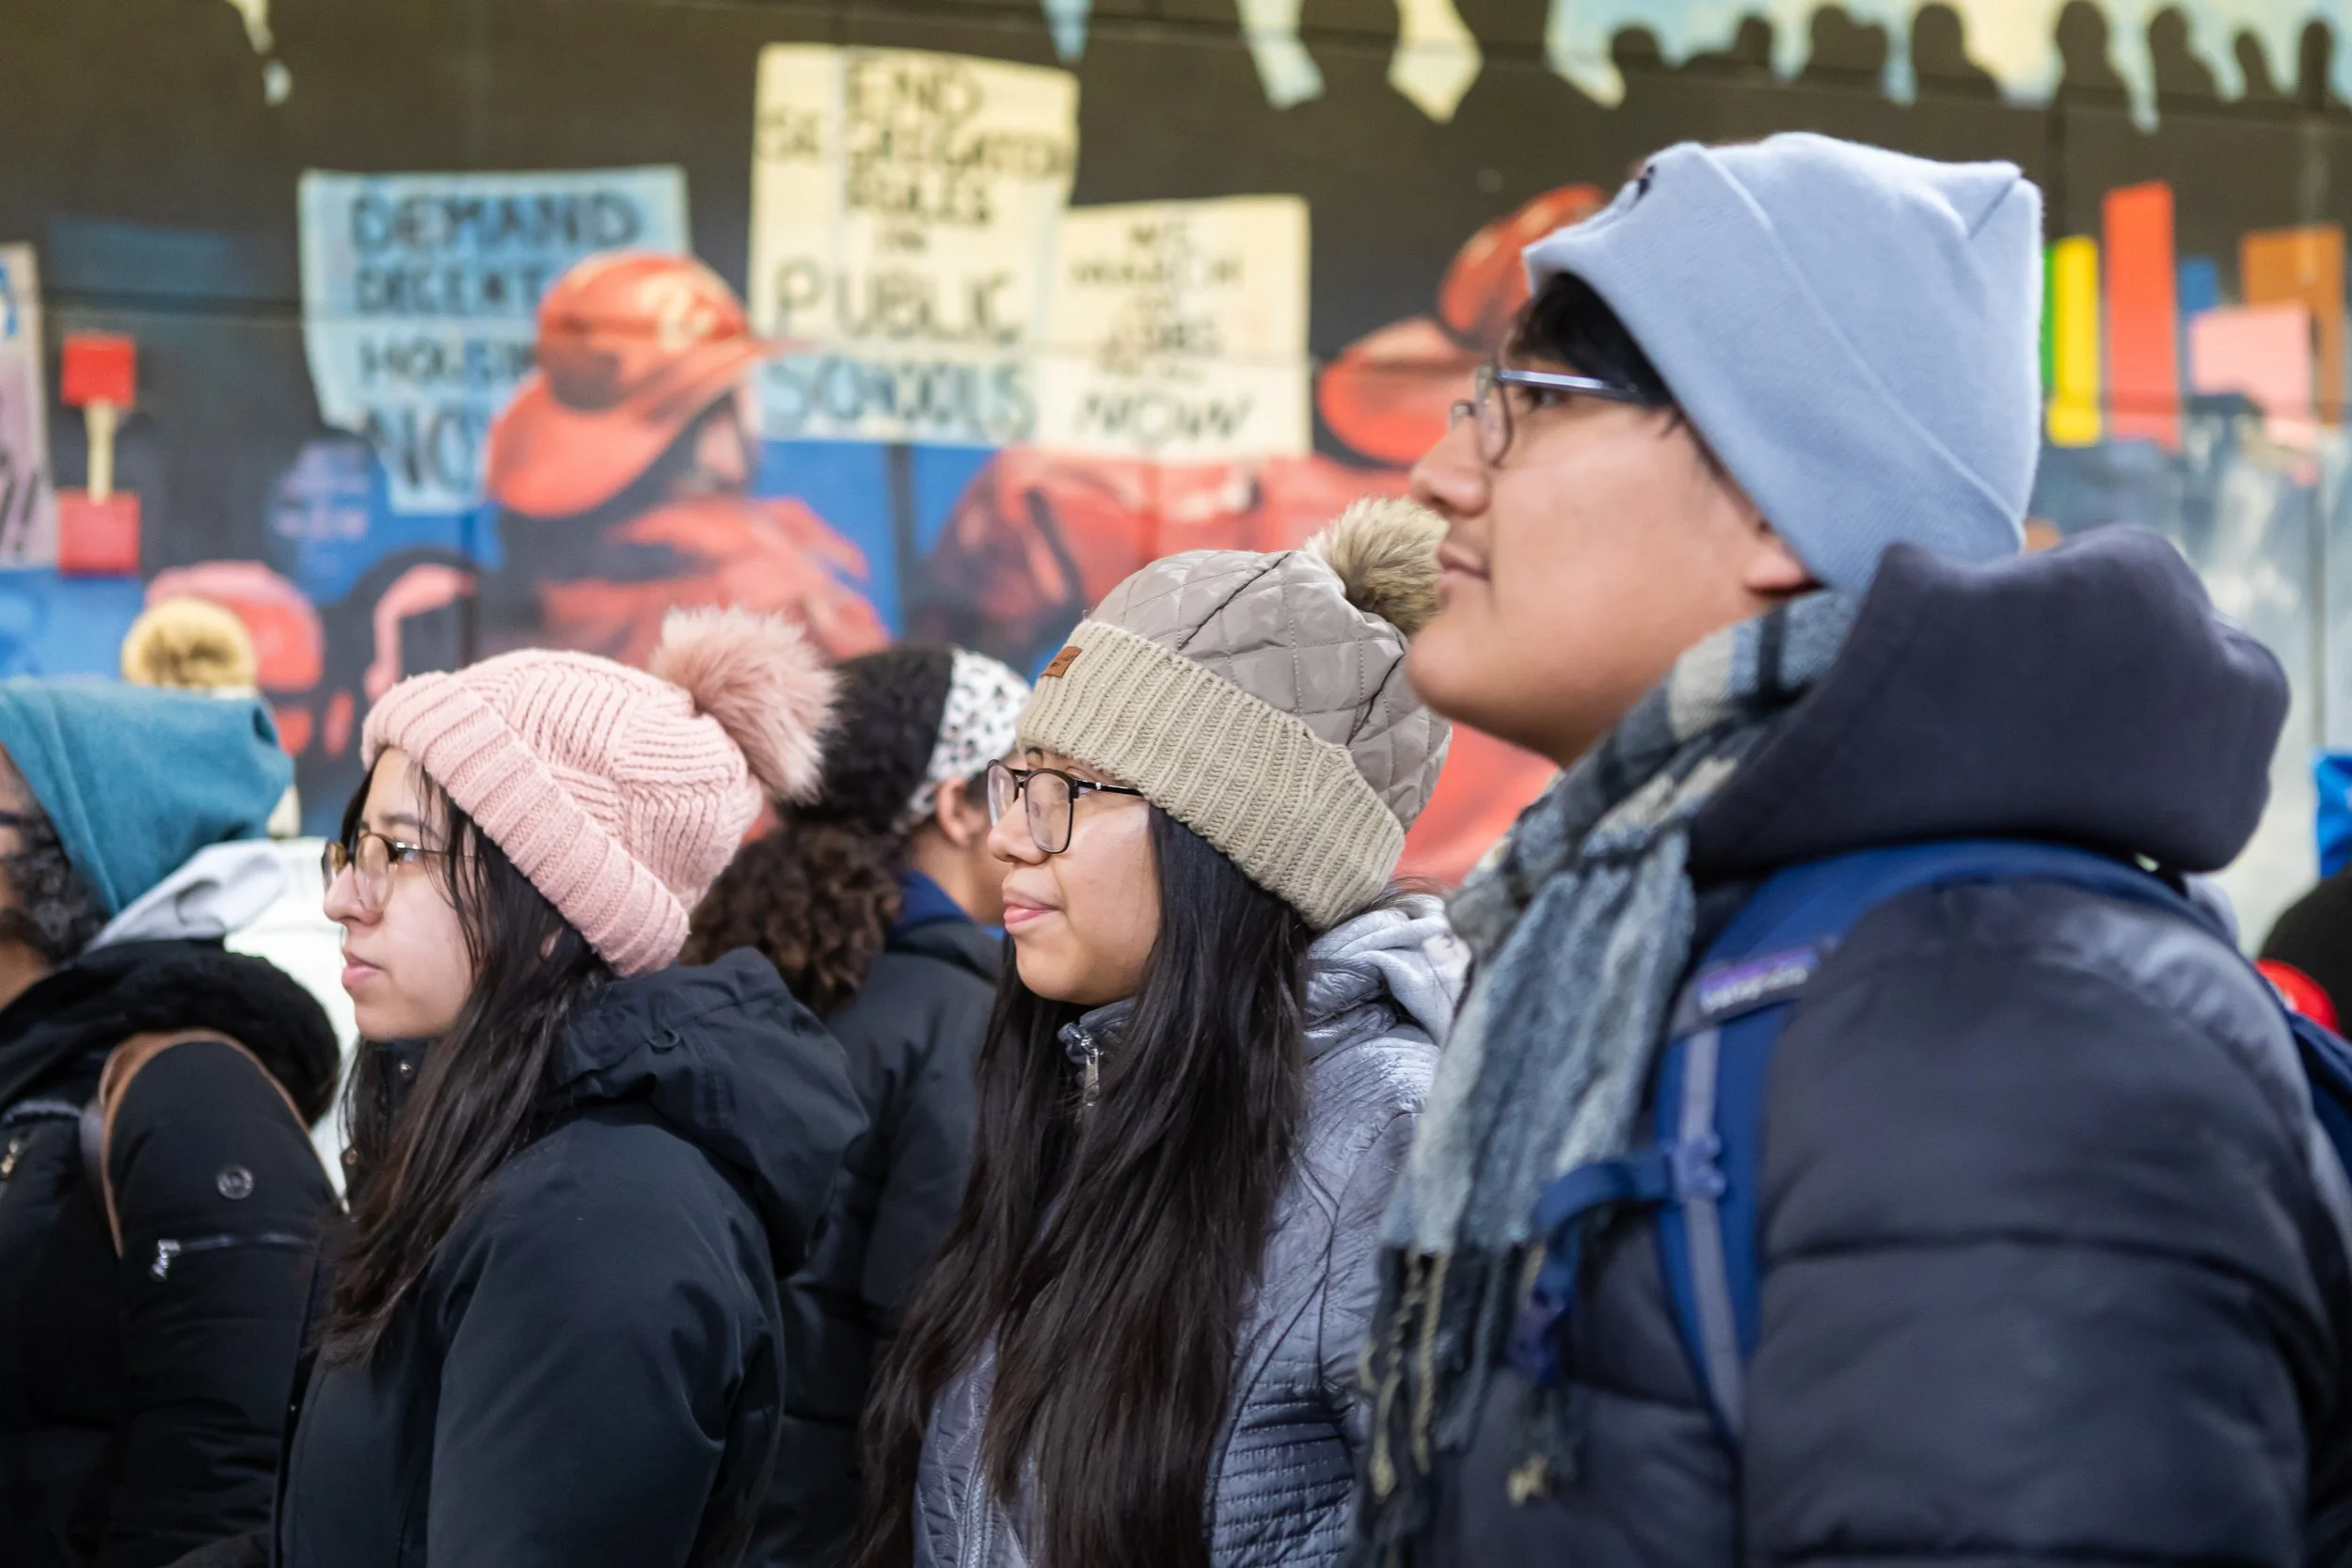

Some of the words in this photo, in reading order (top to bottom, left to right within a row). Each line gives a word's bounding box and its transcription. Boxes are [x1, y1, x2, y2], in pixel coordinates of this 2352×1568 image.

[352, 193, 643, 252] DEMAND
[773, 257, 1022, 346] PUBLIC
[358, 337, 543, 386] HOUSIN
[1073, 388, 1256, 447] NOW
[364, 403, 487, 494] NO
